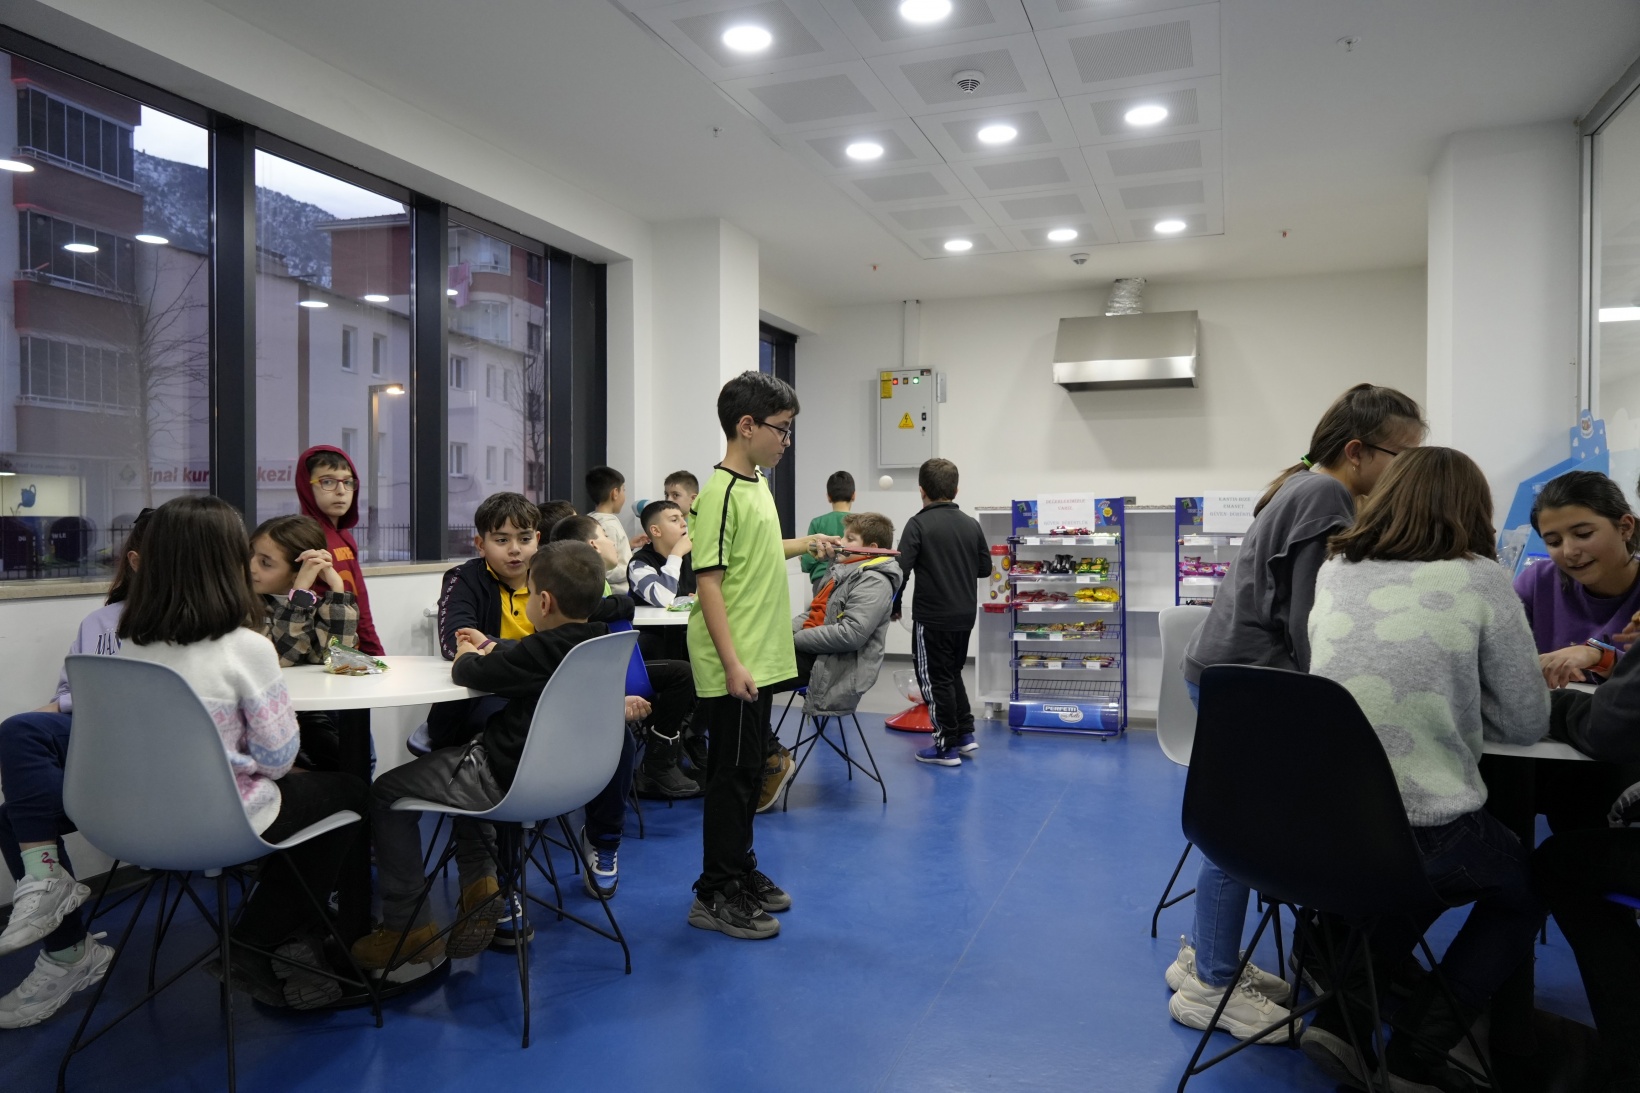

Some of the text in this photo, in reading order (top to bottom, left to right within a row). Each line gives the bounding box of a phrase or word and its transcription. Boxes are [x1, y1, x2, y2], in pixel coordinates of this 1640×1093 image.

[149, 466, 292, 483] inal kur kezi
